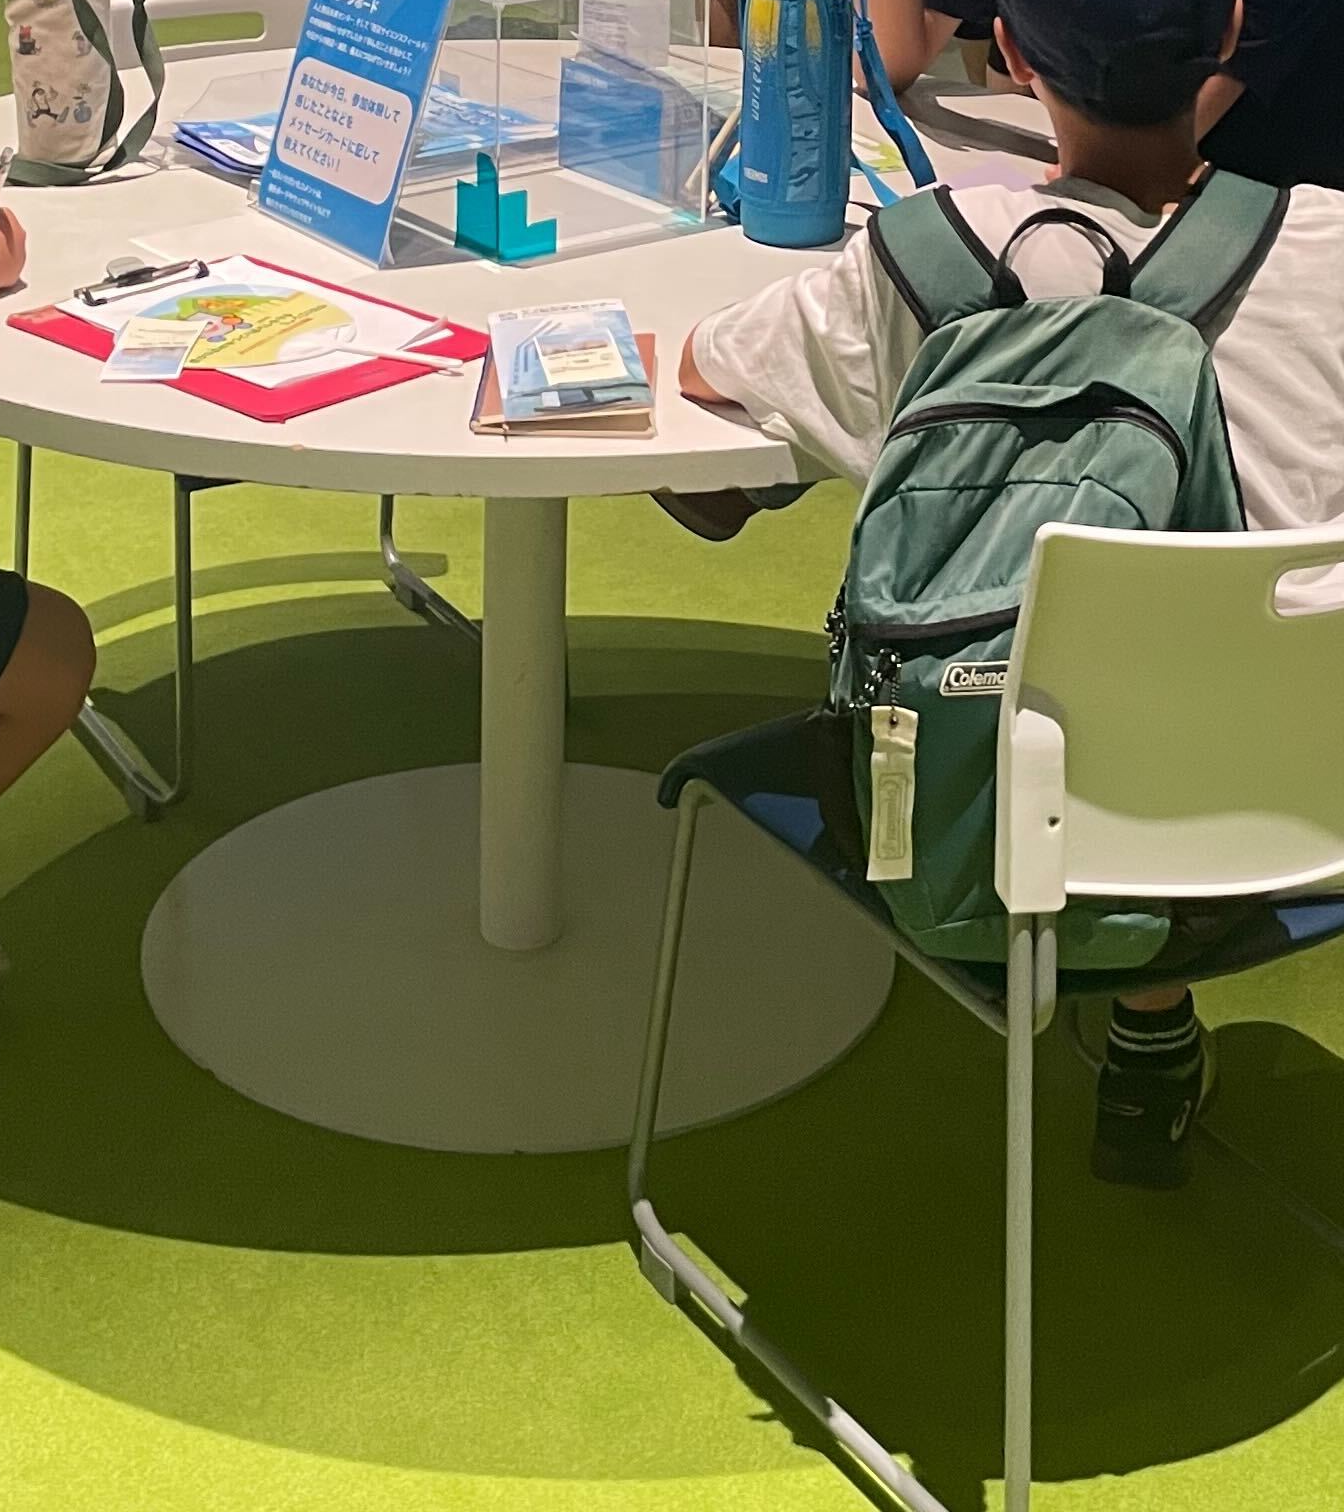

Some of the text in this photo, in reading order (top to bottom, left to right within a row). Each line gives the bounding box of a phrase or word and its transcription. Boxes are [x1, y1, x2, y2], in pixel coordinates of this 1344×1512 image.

[294, 94, 353, 129] 感じたことなどを
